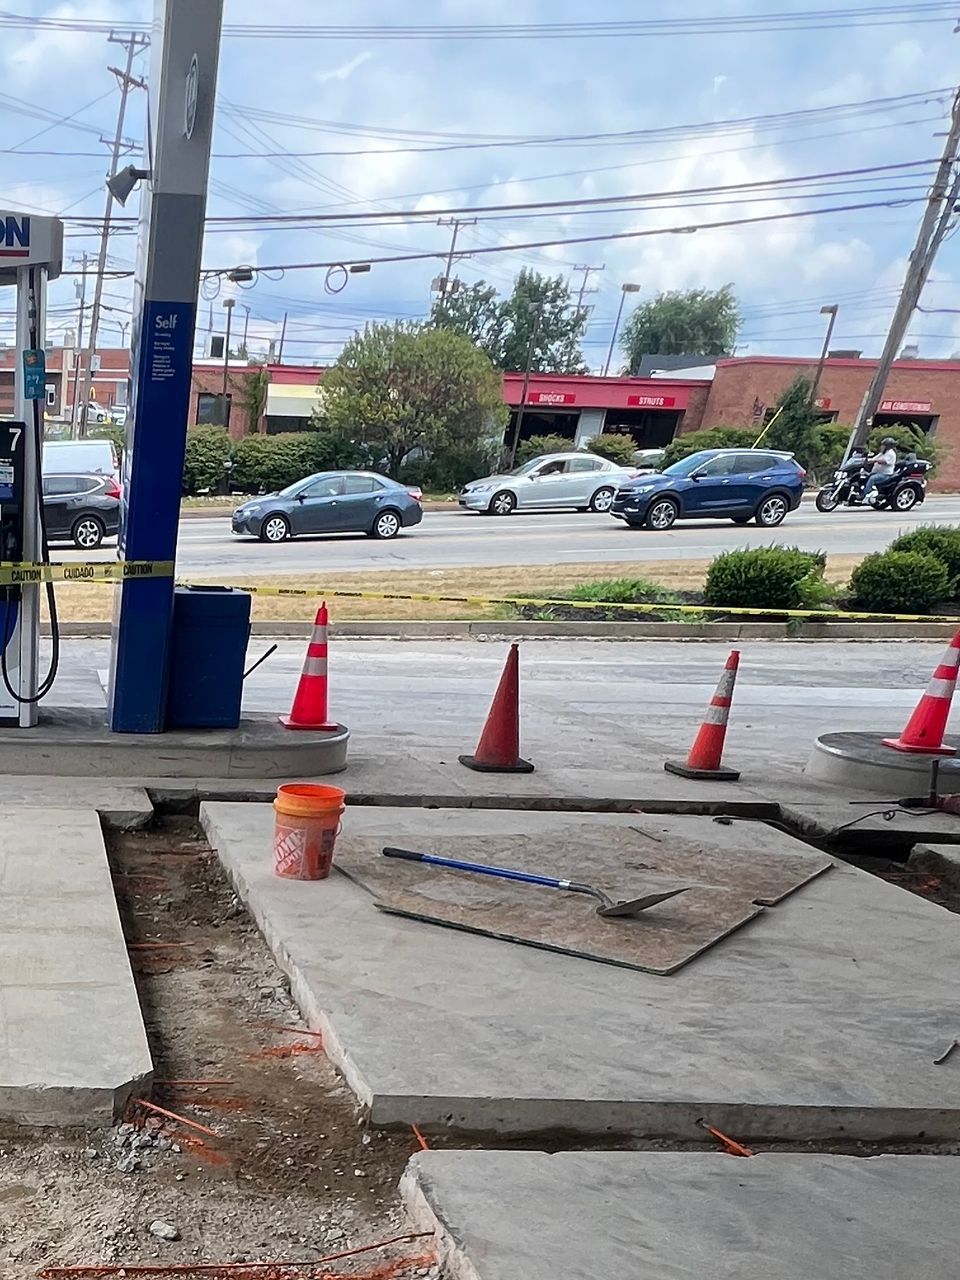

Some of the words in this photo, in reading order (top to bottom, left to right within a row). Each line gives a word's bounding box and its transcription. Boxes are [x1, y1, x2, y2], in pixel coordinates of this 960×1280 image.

[155, 314, 178, 329] Self
[539, 393, 565, 403] SHOCKS
[638, 397, 664, 406] STRUTS
[9, 428, 22, 451] 7
[11, 569, 42, 581] CAUTION
[63, 567, 94, 579] CUIDADO
[123, 564, 153, 575] CAUTION
[275, 830, 302, 862] OME
